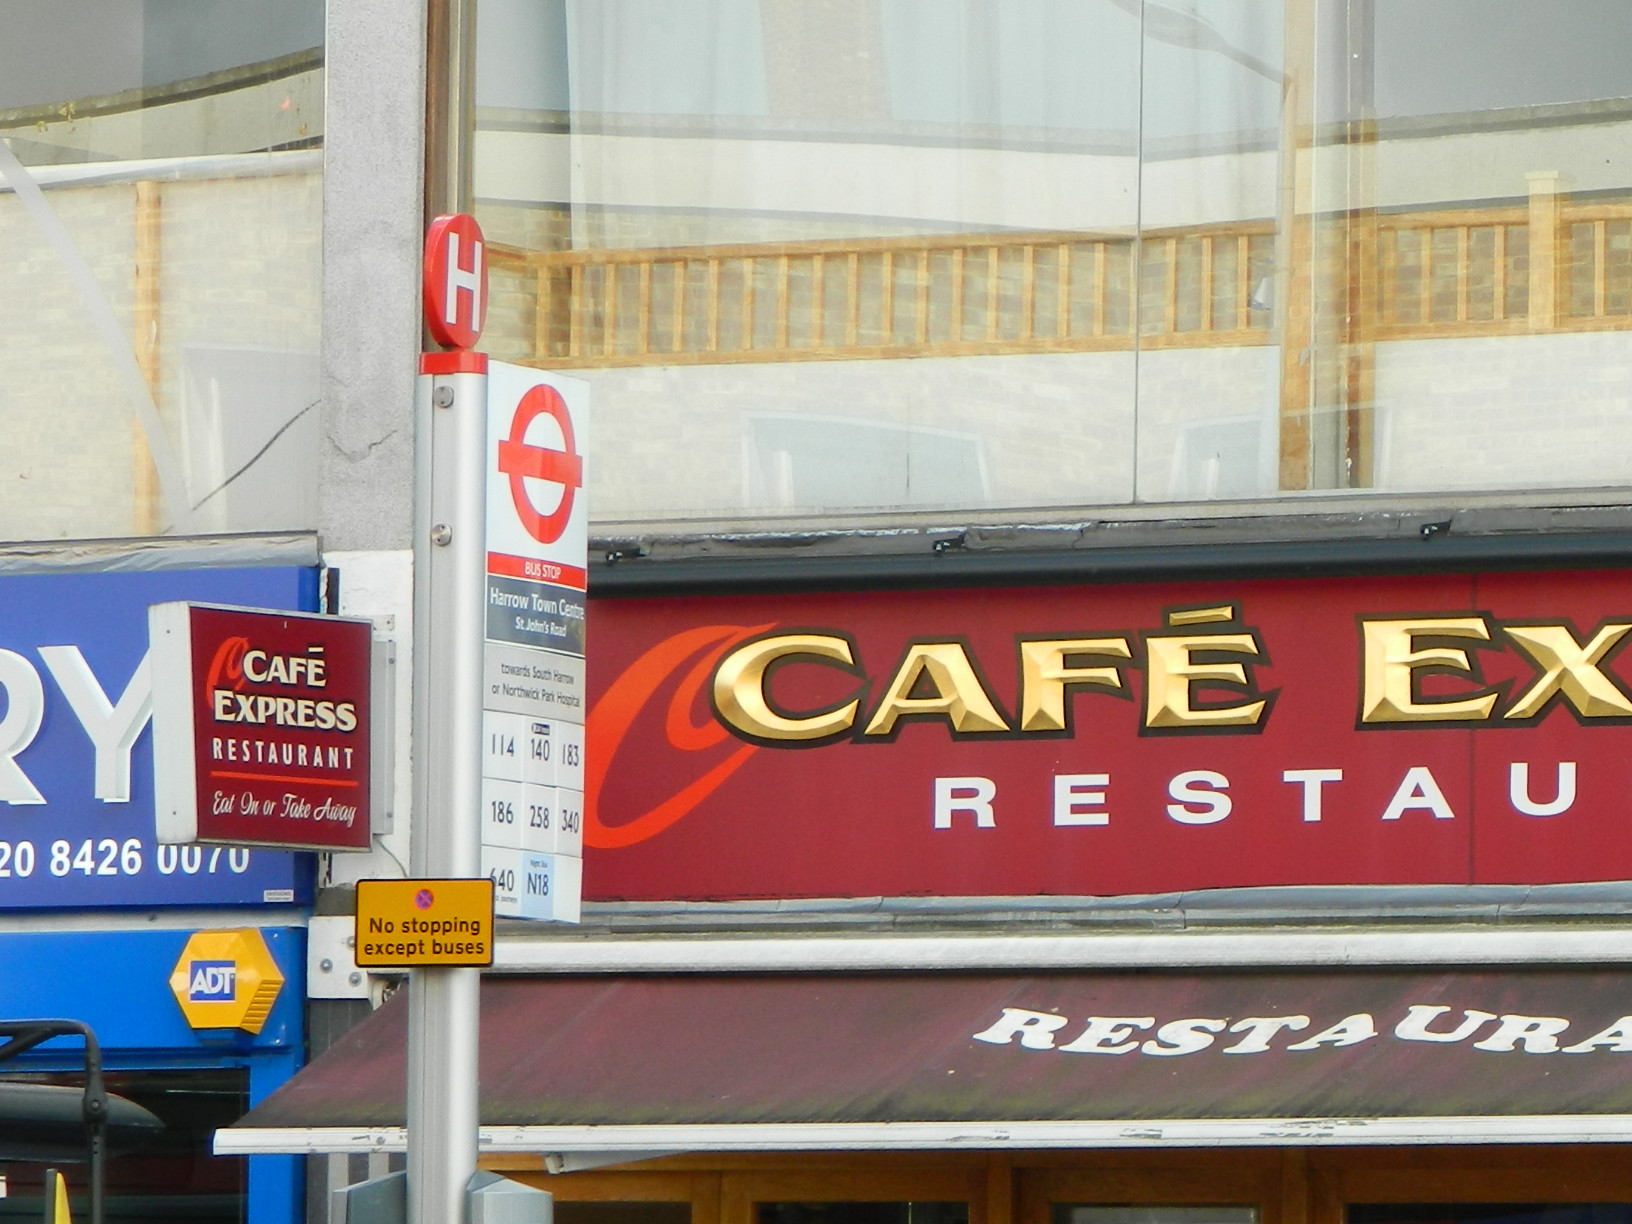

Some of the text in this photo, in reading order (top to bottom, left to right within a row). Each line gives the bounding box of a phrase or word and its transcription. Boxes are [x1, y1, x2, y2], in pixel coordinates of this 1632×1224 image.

[445, 232, 482, 332] H
[525, 562, 562, 580] BUS STOP
[490, 587, 585, 620] Harrow Town Centre
[525, 618, 549, 634] John's
[550, 622, 567, 637] Road
[501, 663, 575, 685] towards South Harrow
[492, 684, 501, 695] or
[502, 683, 540, 700] Northwick
[213, 689, 358, 732] EXPRESS
[212, 737, 354, 770] RESTAURANT
[492, 733, 580, 767] 114 140 183
[263, 801, 277, 815] or
[280, 793, 312, 819] Take
[313, 796, 358, 828] Away
[491, 800, 580, 834] 186 258 340
[50, 839, 142, 876] 8426
[157, 845, 250, 875] 0070
[527, 872, 550, 897] N18
[369, 917, 480, 936] No stopping
[364, 939, 485, 957] except buses
[190, 966, 237, 995] ADT
